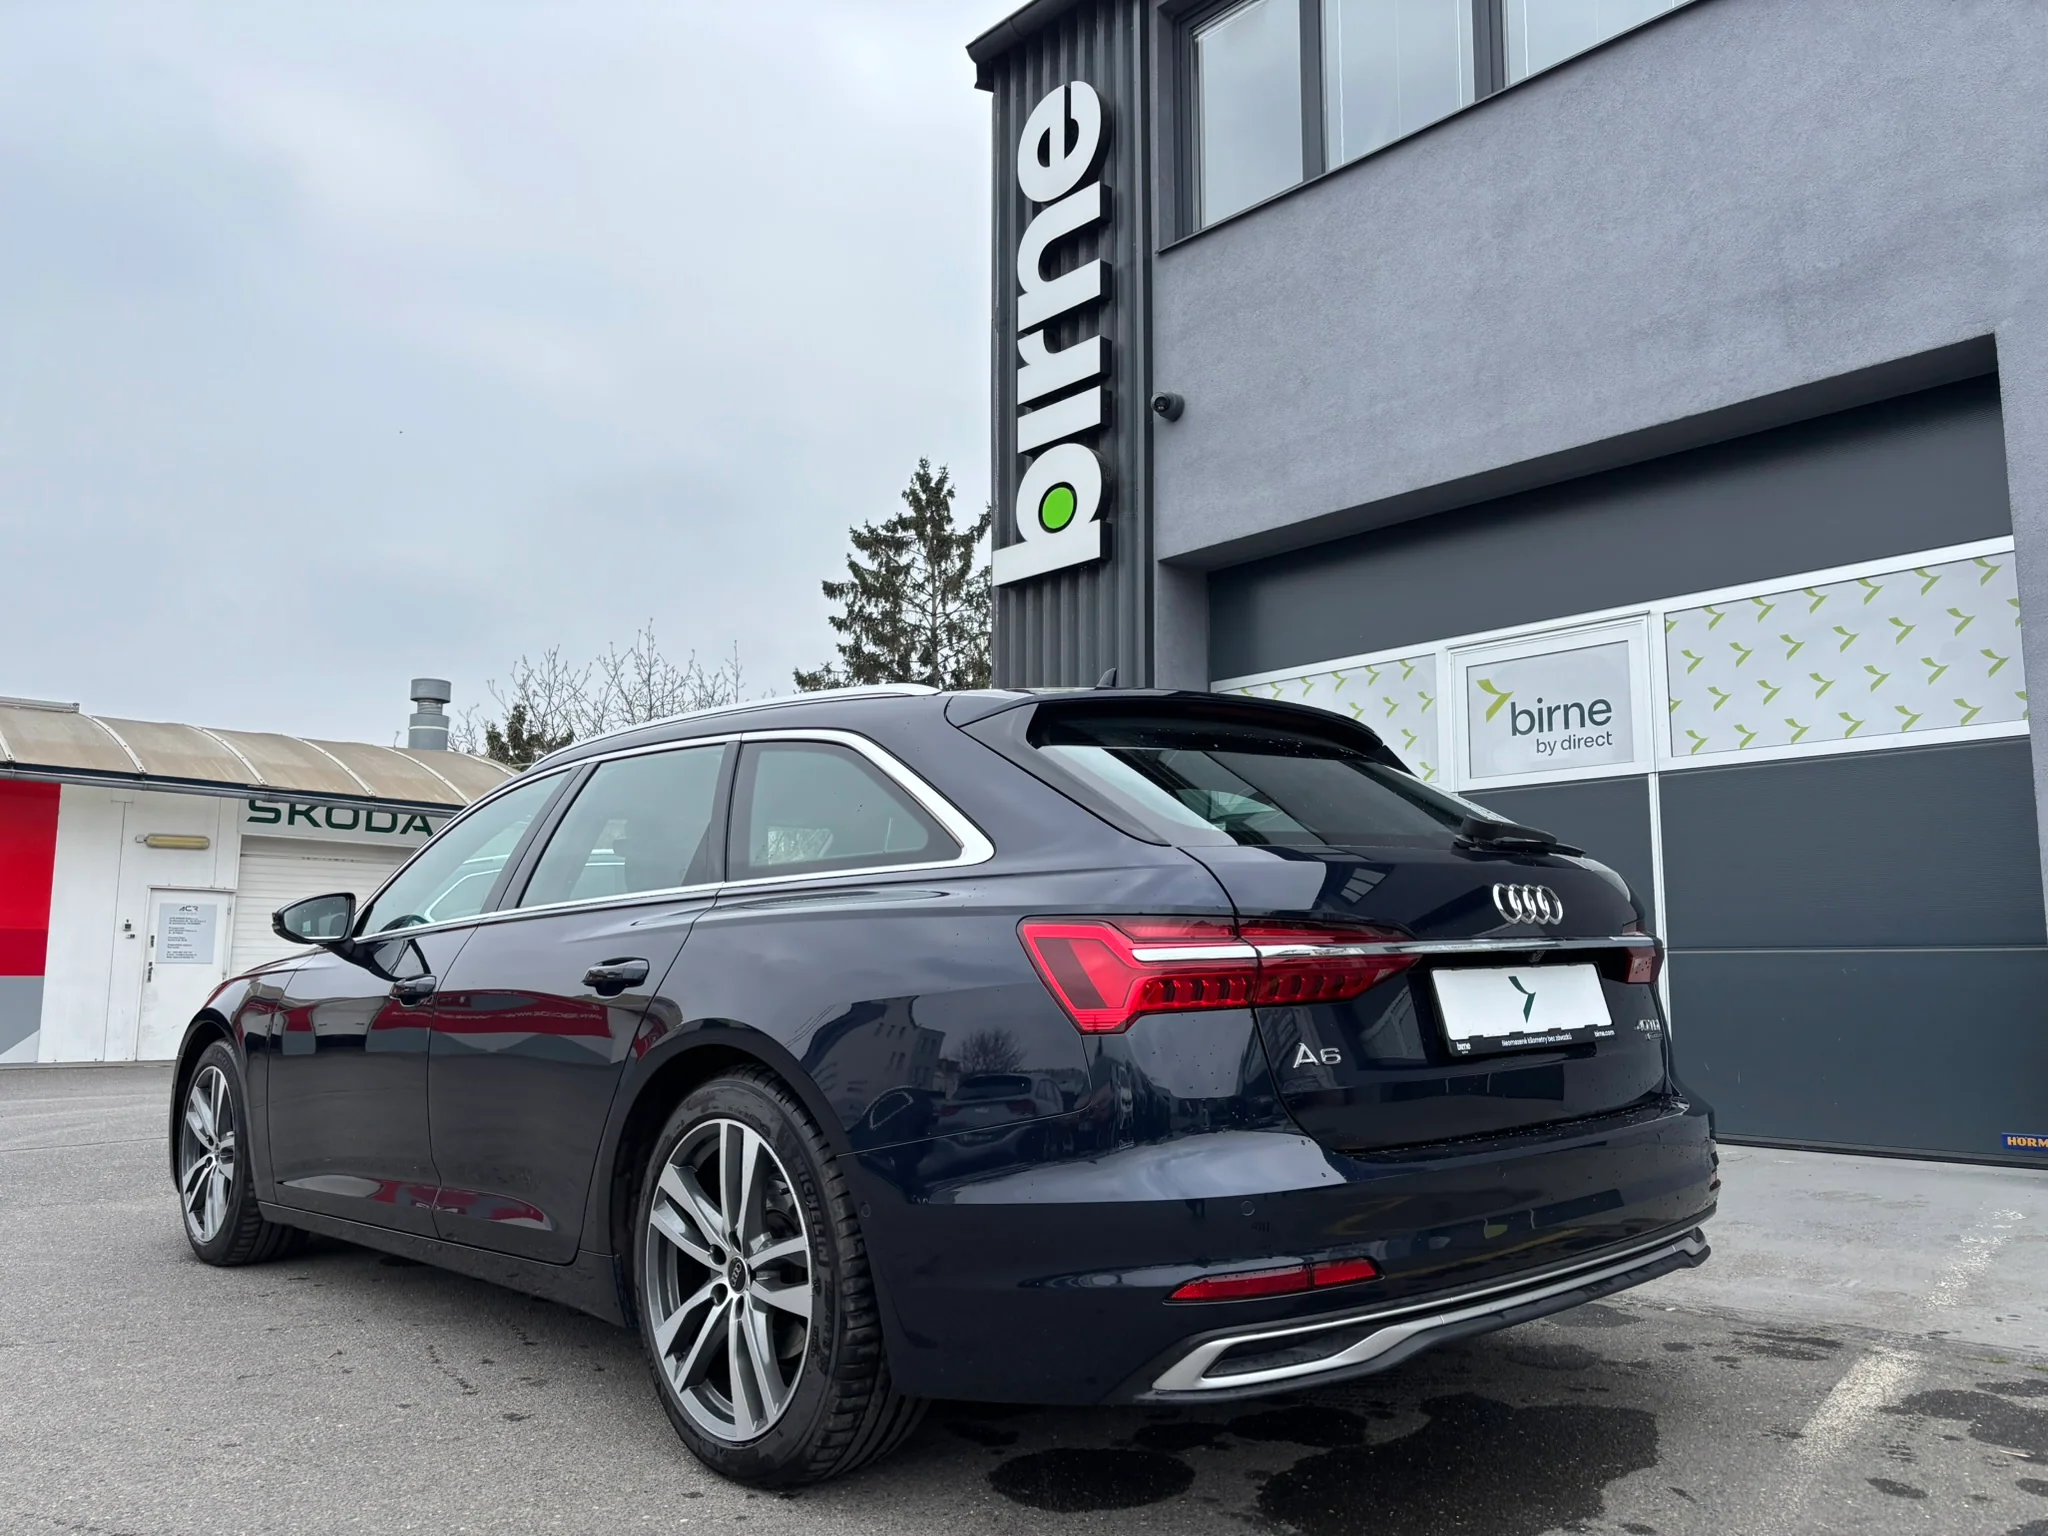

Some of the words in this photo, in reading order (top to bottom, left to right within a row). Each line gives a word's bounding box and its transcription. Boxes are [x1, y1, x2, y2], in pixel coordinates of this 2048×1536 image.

[992, 80, 1102, 588] birne
[1510, 697, 1613, 737] birne
[1536, 738, 1557, 756] by
[1560, 730, 1613, 751] direct
[1293, 1042, 1342, 1069] A6
